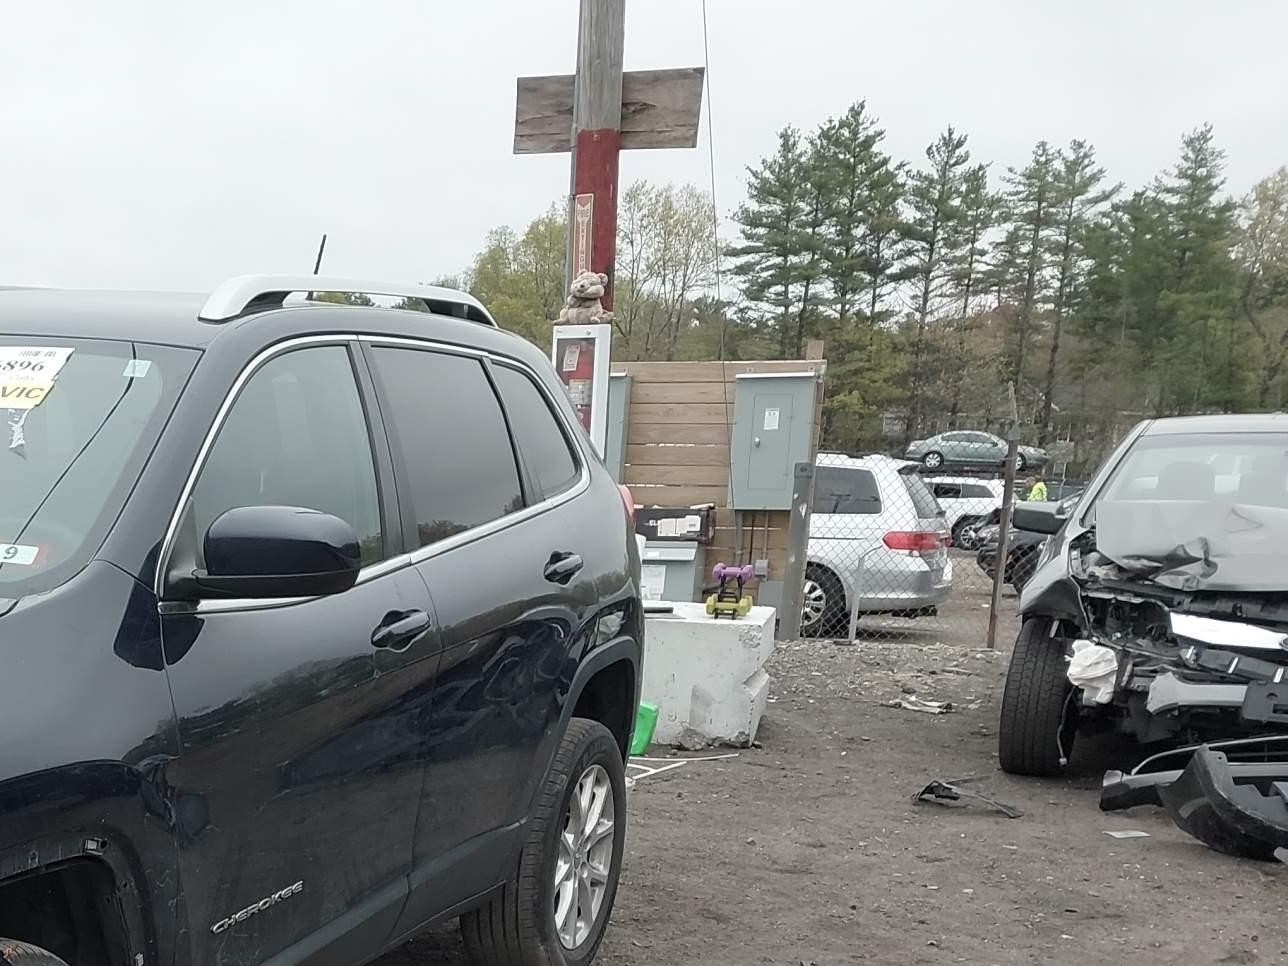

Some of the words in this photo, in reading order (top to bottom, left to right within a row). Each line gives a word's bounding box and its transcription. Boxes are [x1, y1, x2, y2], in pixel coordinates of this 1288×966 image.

[0, 385, 45, 400] VIC
[2, 546, 18, 560] 9
[212, 880, 303, 935] CHEROKEE
